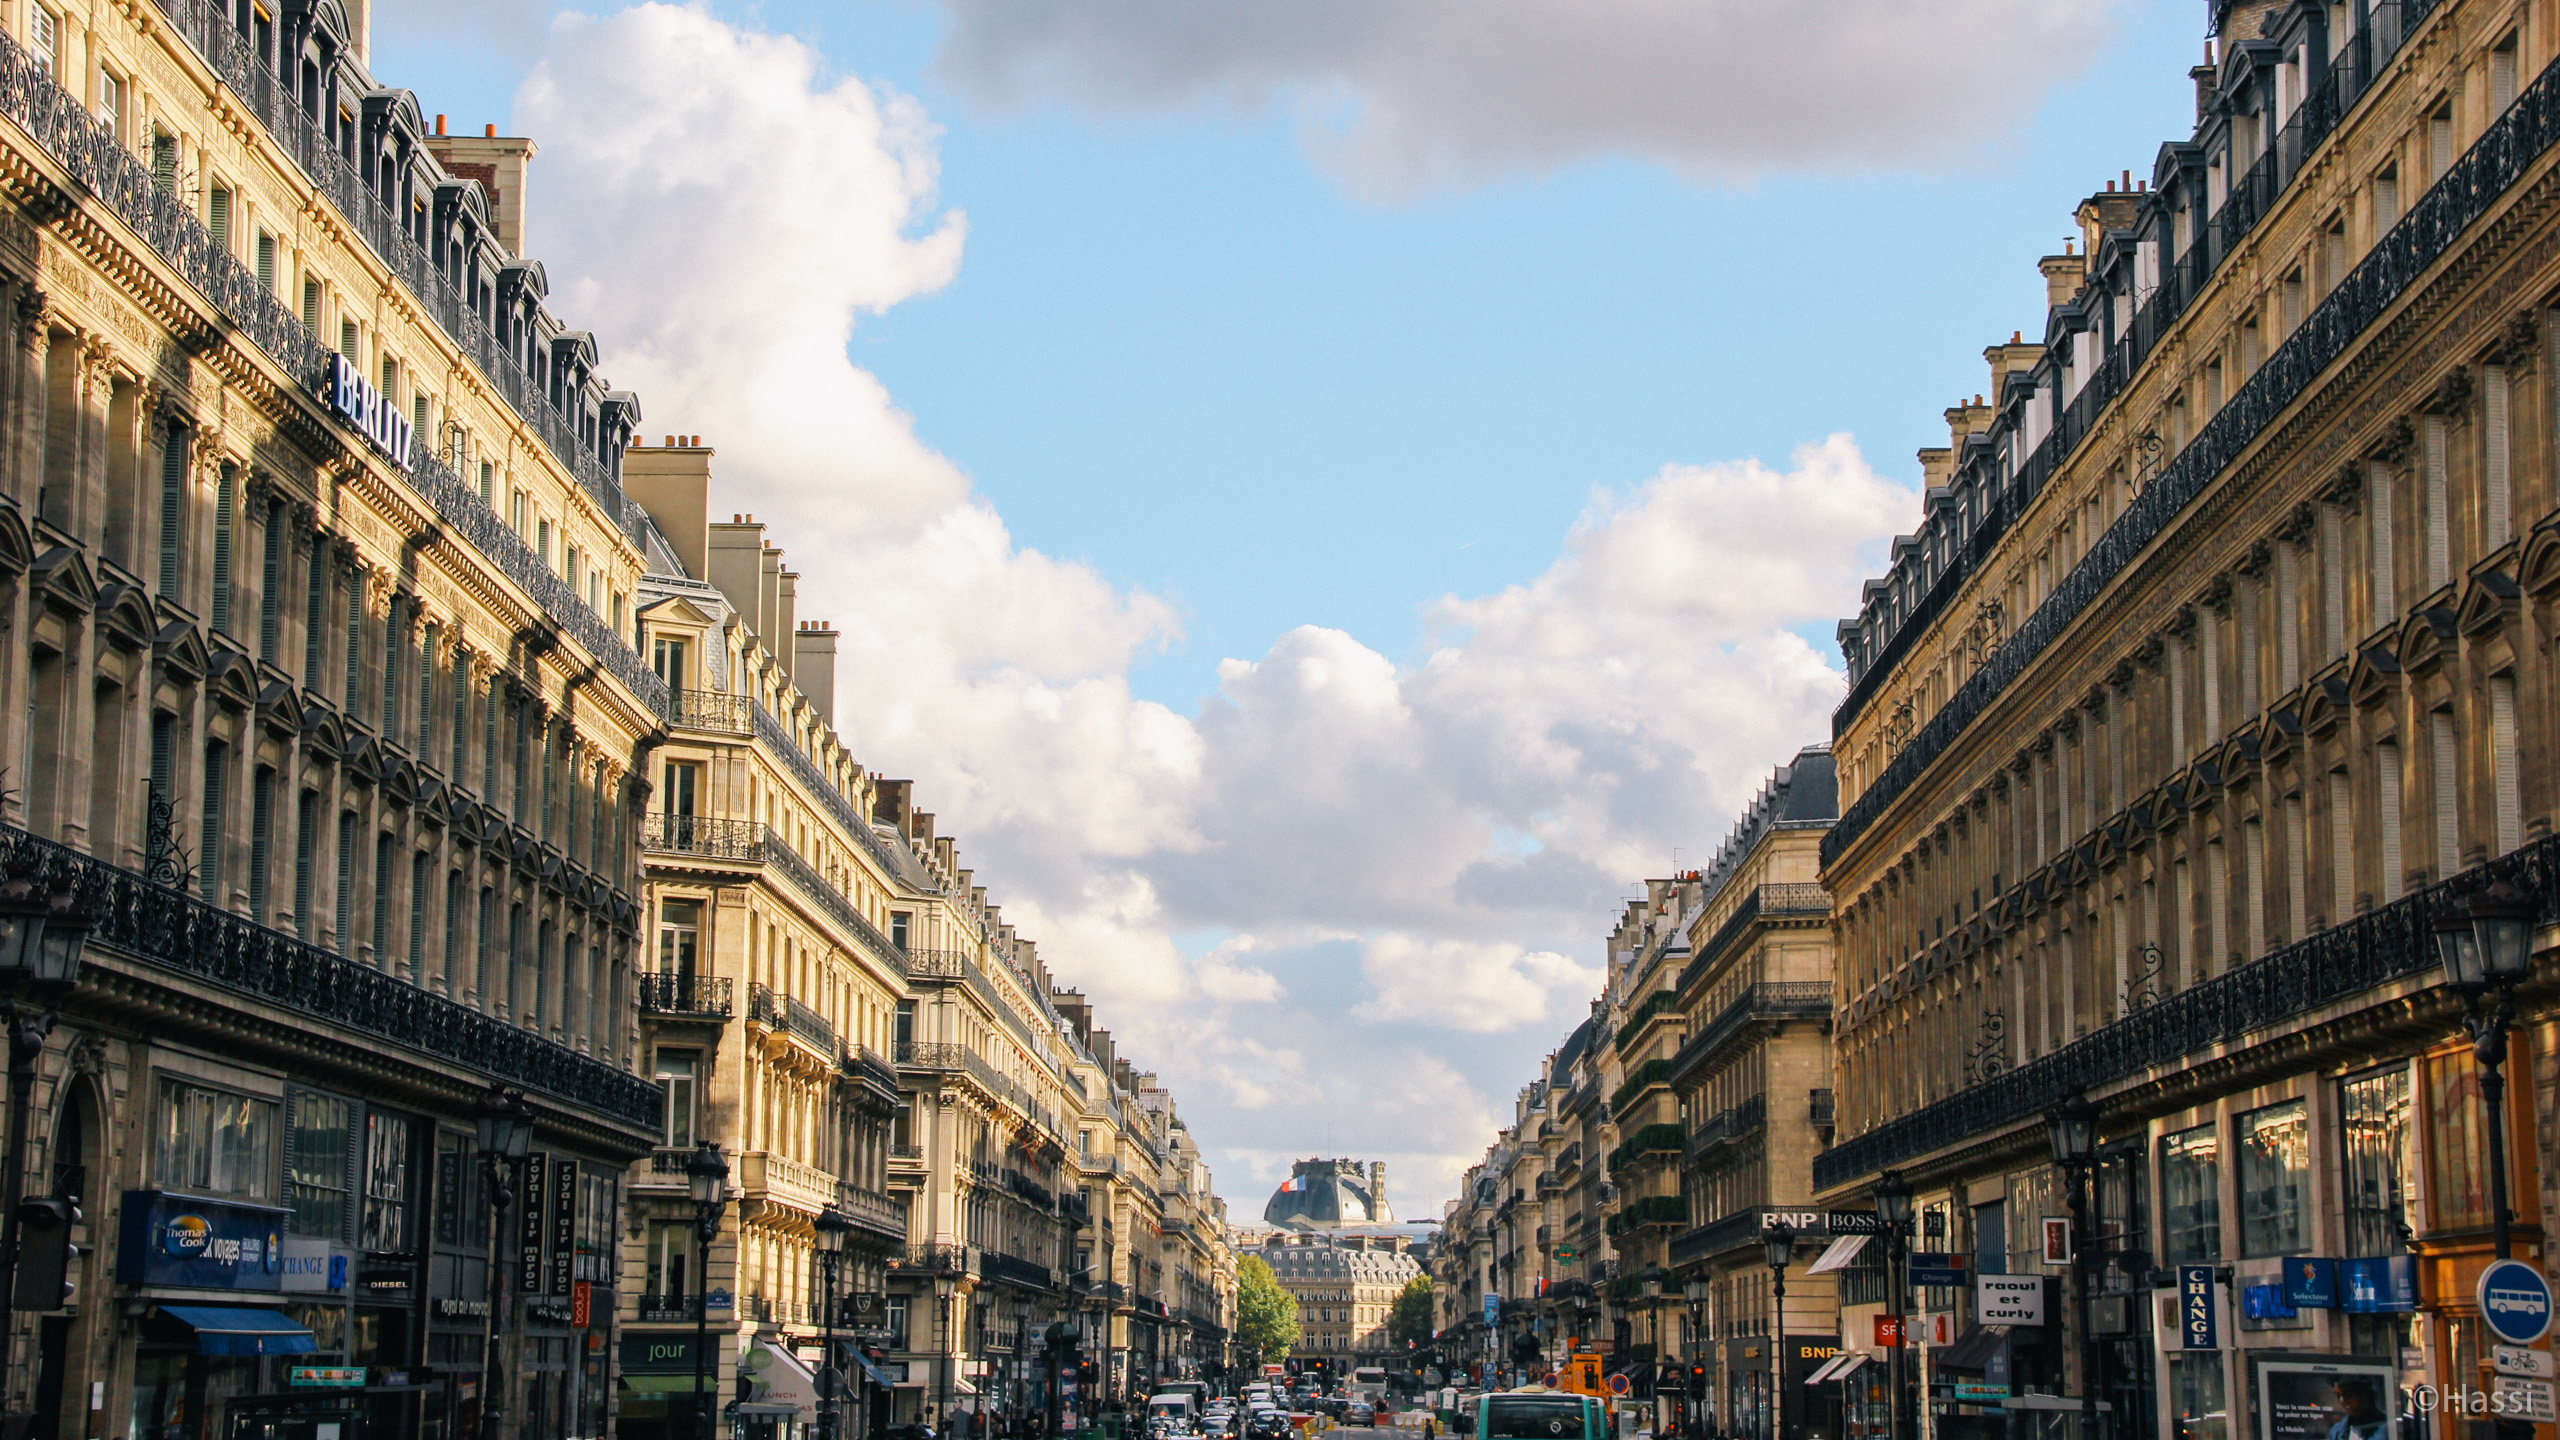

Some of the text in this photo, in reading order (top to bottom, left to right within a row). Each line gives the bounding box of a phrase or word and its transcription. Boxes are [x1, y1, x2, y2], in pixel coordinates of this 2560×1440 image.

[337, 353, 413, 473] BERLITZ
[524, 1156, 540, 1289] royal air maroc
[1762, 1212, 1818, 1229] BNP
[1832, 1214, 1876, 1227] BOSS
[166, 1228, 207, 1238] Thomas
[556, 1165, 572, 1292] royal air maroc
[179, 1237, 206, 1248] Cook
[214, 1238, 240, 1266] voyages
[1985, 1282, 2036, 1290] raoul
[1317, 1294, 1353, 1302] LOUVRE
[1999, 1296, 2021, 1304] et
[1986, 1310, 2034, 1319] curly
[2188, 1270, 2208, 1346] CHANGE
[648, 1344, 686, 1362] jour
